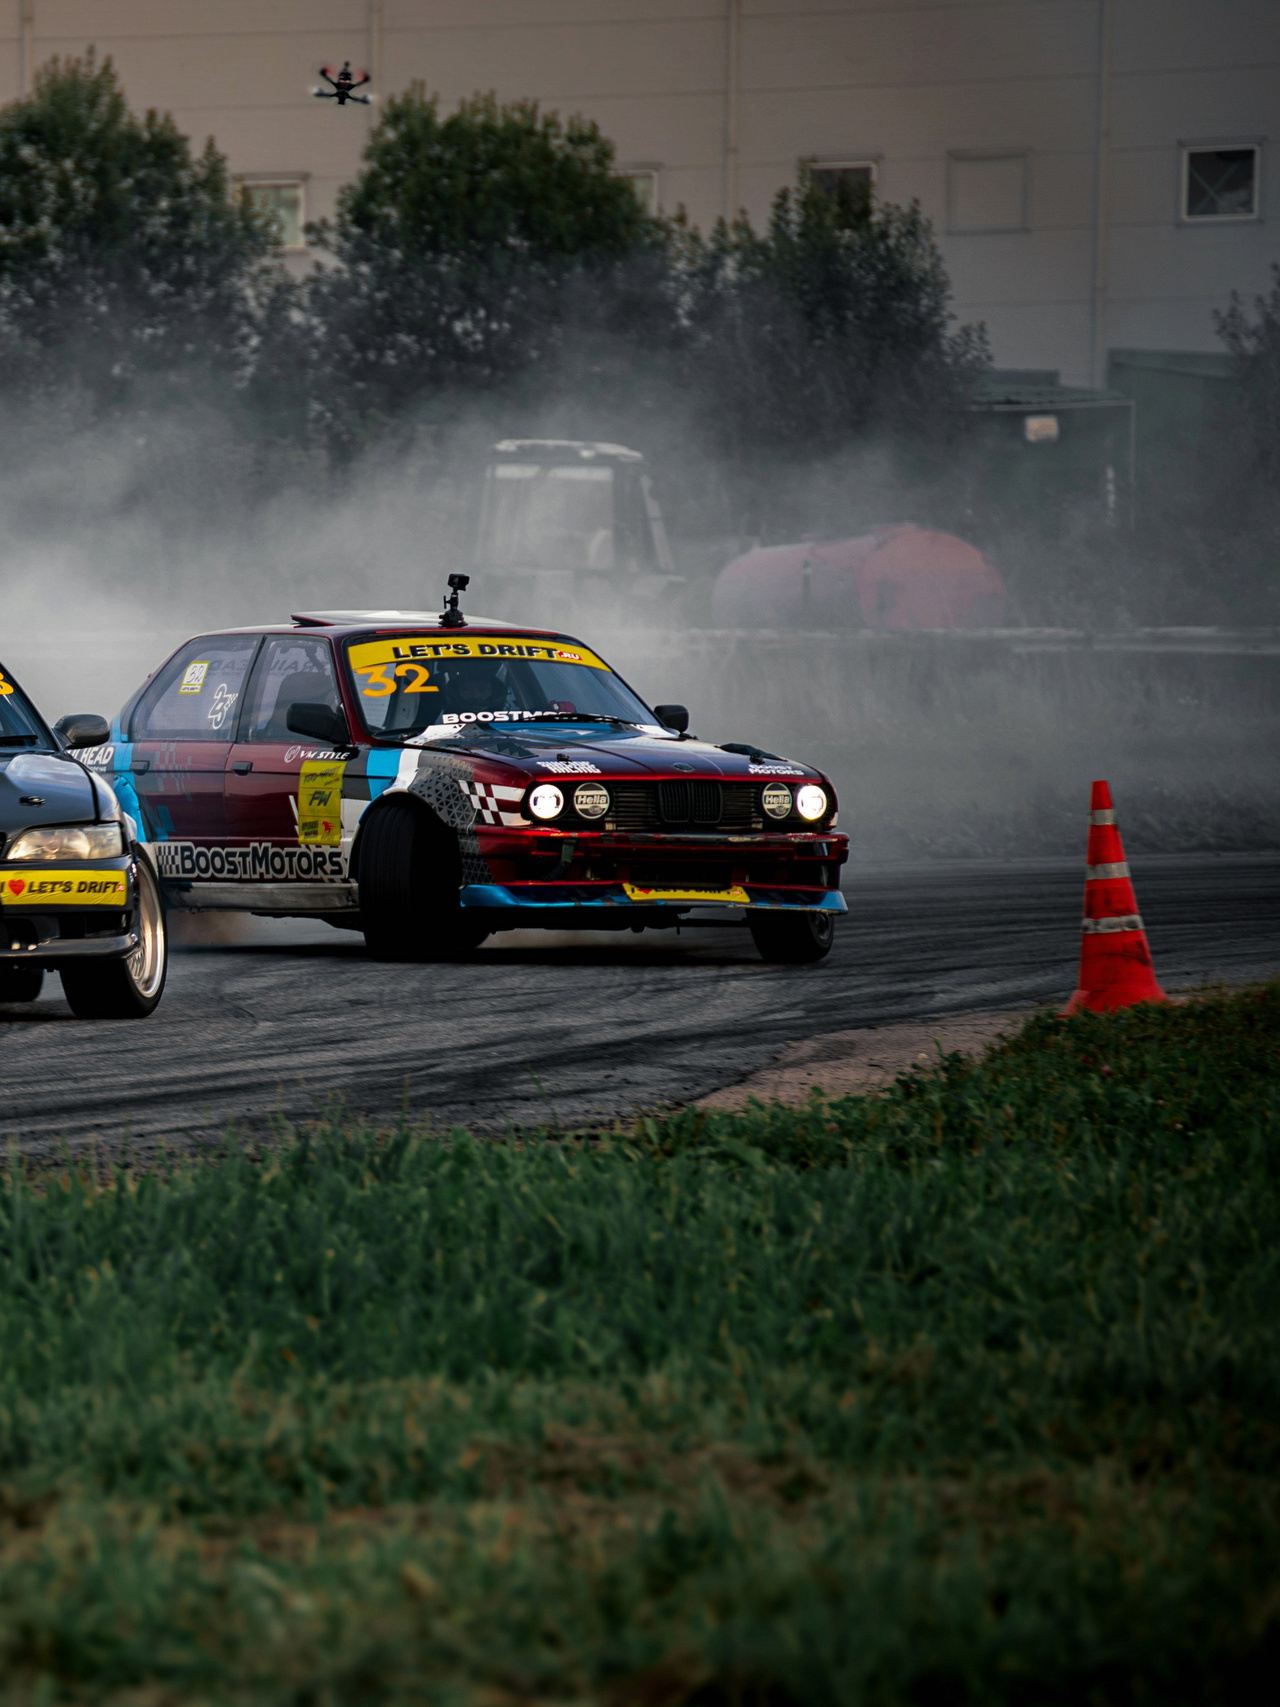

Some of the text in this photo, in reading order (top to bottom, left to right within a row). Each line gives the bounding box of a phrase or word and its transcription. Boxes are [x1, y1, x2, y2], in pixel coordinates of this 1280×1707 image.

[392, 643, 472, 660] LET'S
[355, 663, 440, 698] 32
[80, 746, 115, 765] HEAD
[317, 750, 351, 760] STYLE
[577, 795, 607, 805] Hella
[765, 795, 790, 805] Hella
[26, 881, 73, 894] LET'S
[76, 881, 119, 894] DRIFT
